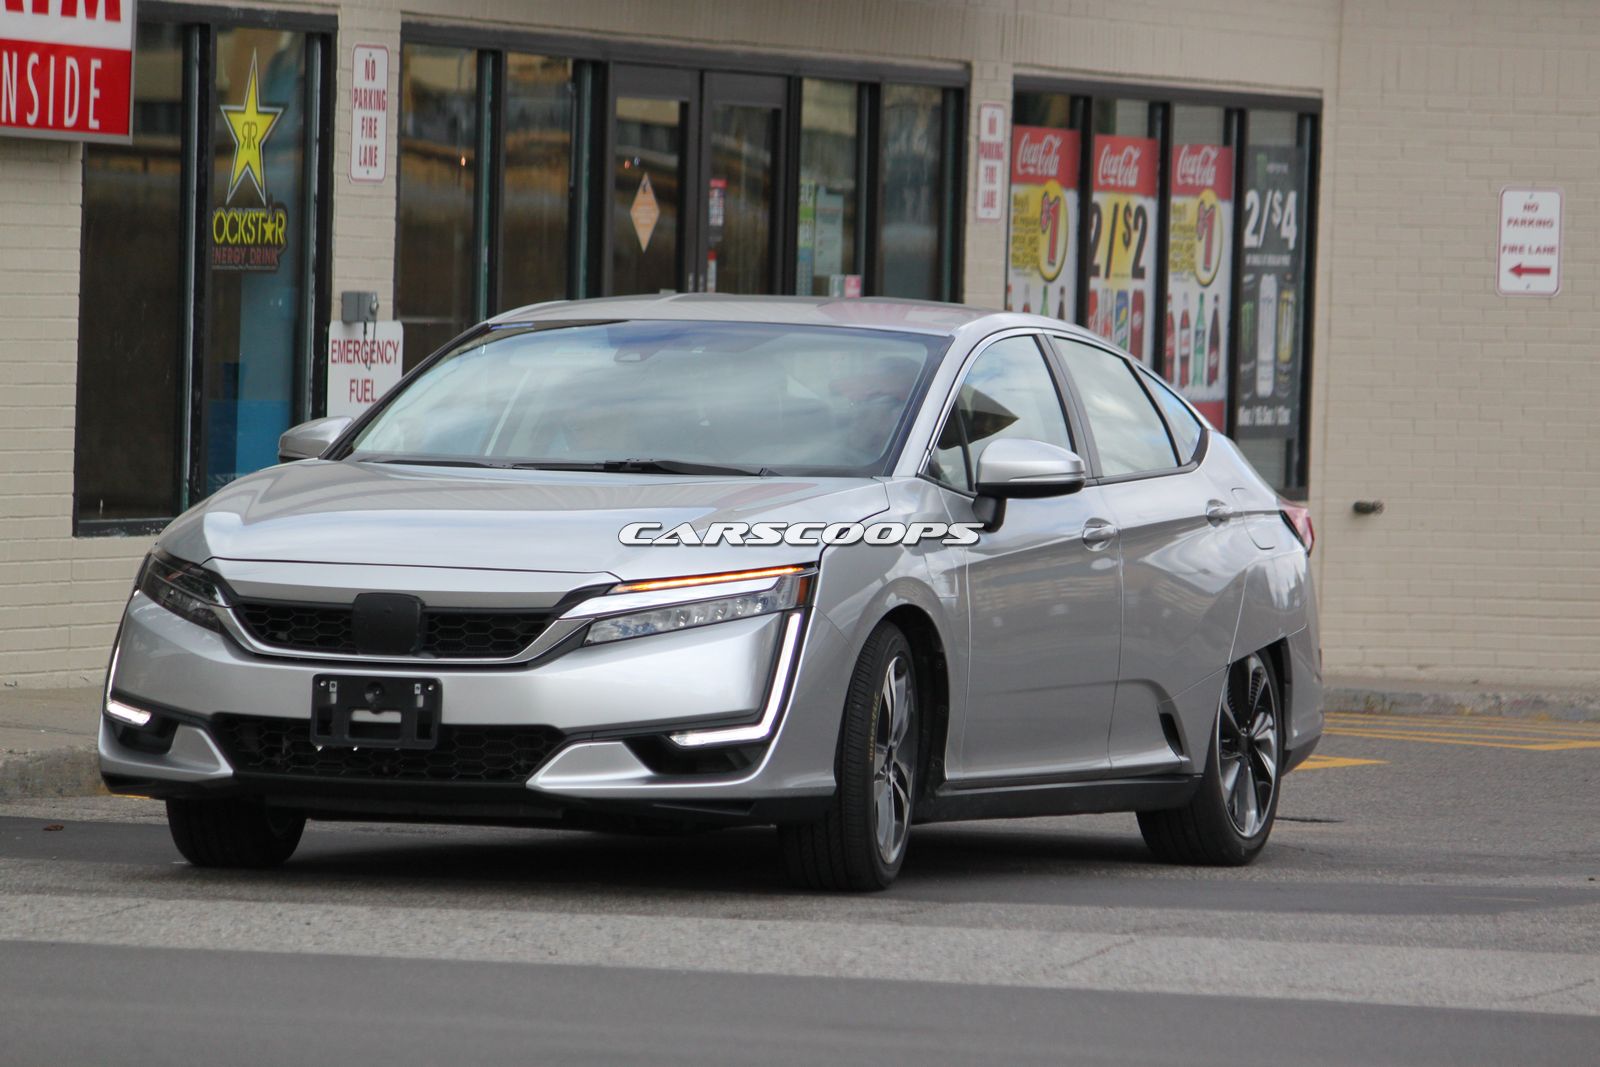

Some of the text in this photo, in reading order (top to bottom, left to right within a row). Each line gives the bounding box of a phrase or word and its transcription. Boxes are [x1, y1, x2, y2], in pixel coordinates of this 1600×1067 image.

[364, 57, 376, 82] NO
[1, 51, 102, 130] NSIDE
[353, 87, 387, 112] PARKING
[360, 116, 379, 140] FIRE
[358, 143, 379, 169] LANE
[1243, 190, 1298, 251] 2/$4
[1522, 203, 1540, 213] NO
[213, 209, 286, 245] OCKSTAR
[1506, 218, 1555, 230] PARKING
[249, 247, 279, 265] DRINK
[1502, 244, 1557, 257] FIRE LANE
[330, 339, 400, 365] EMERGENCY
[349, 378, 377, 404] FUEL
